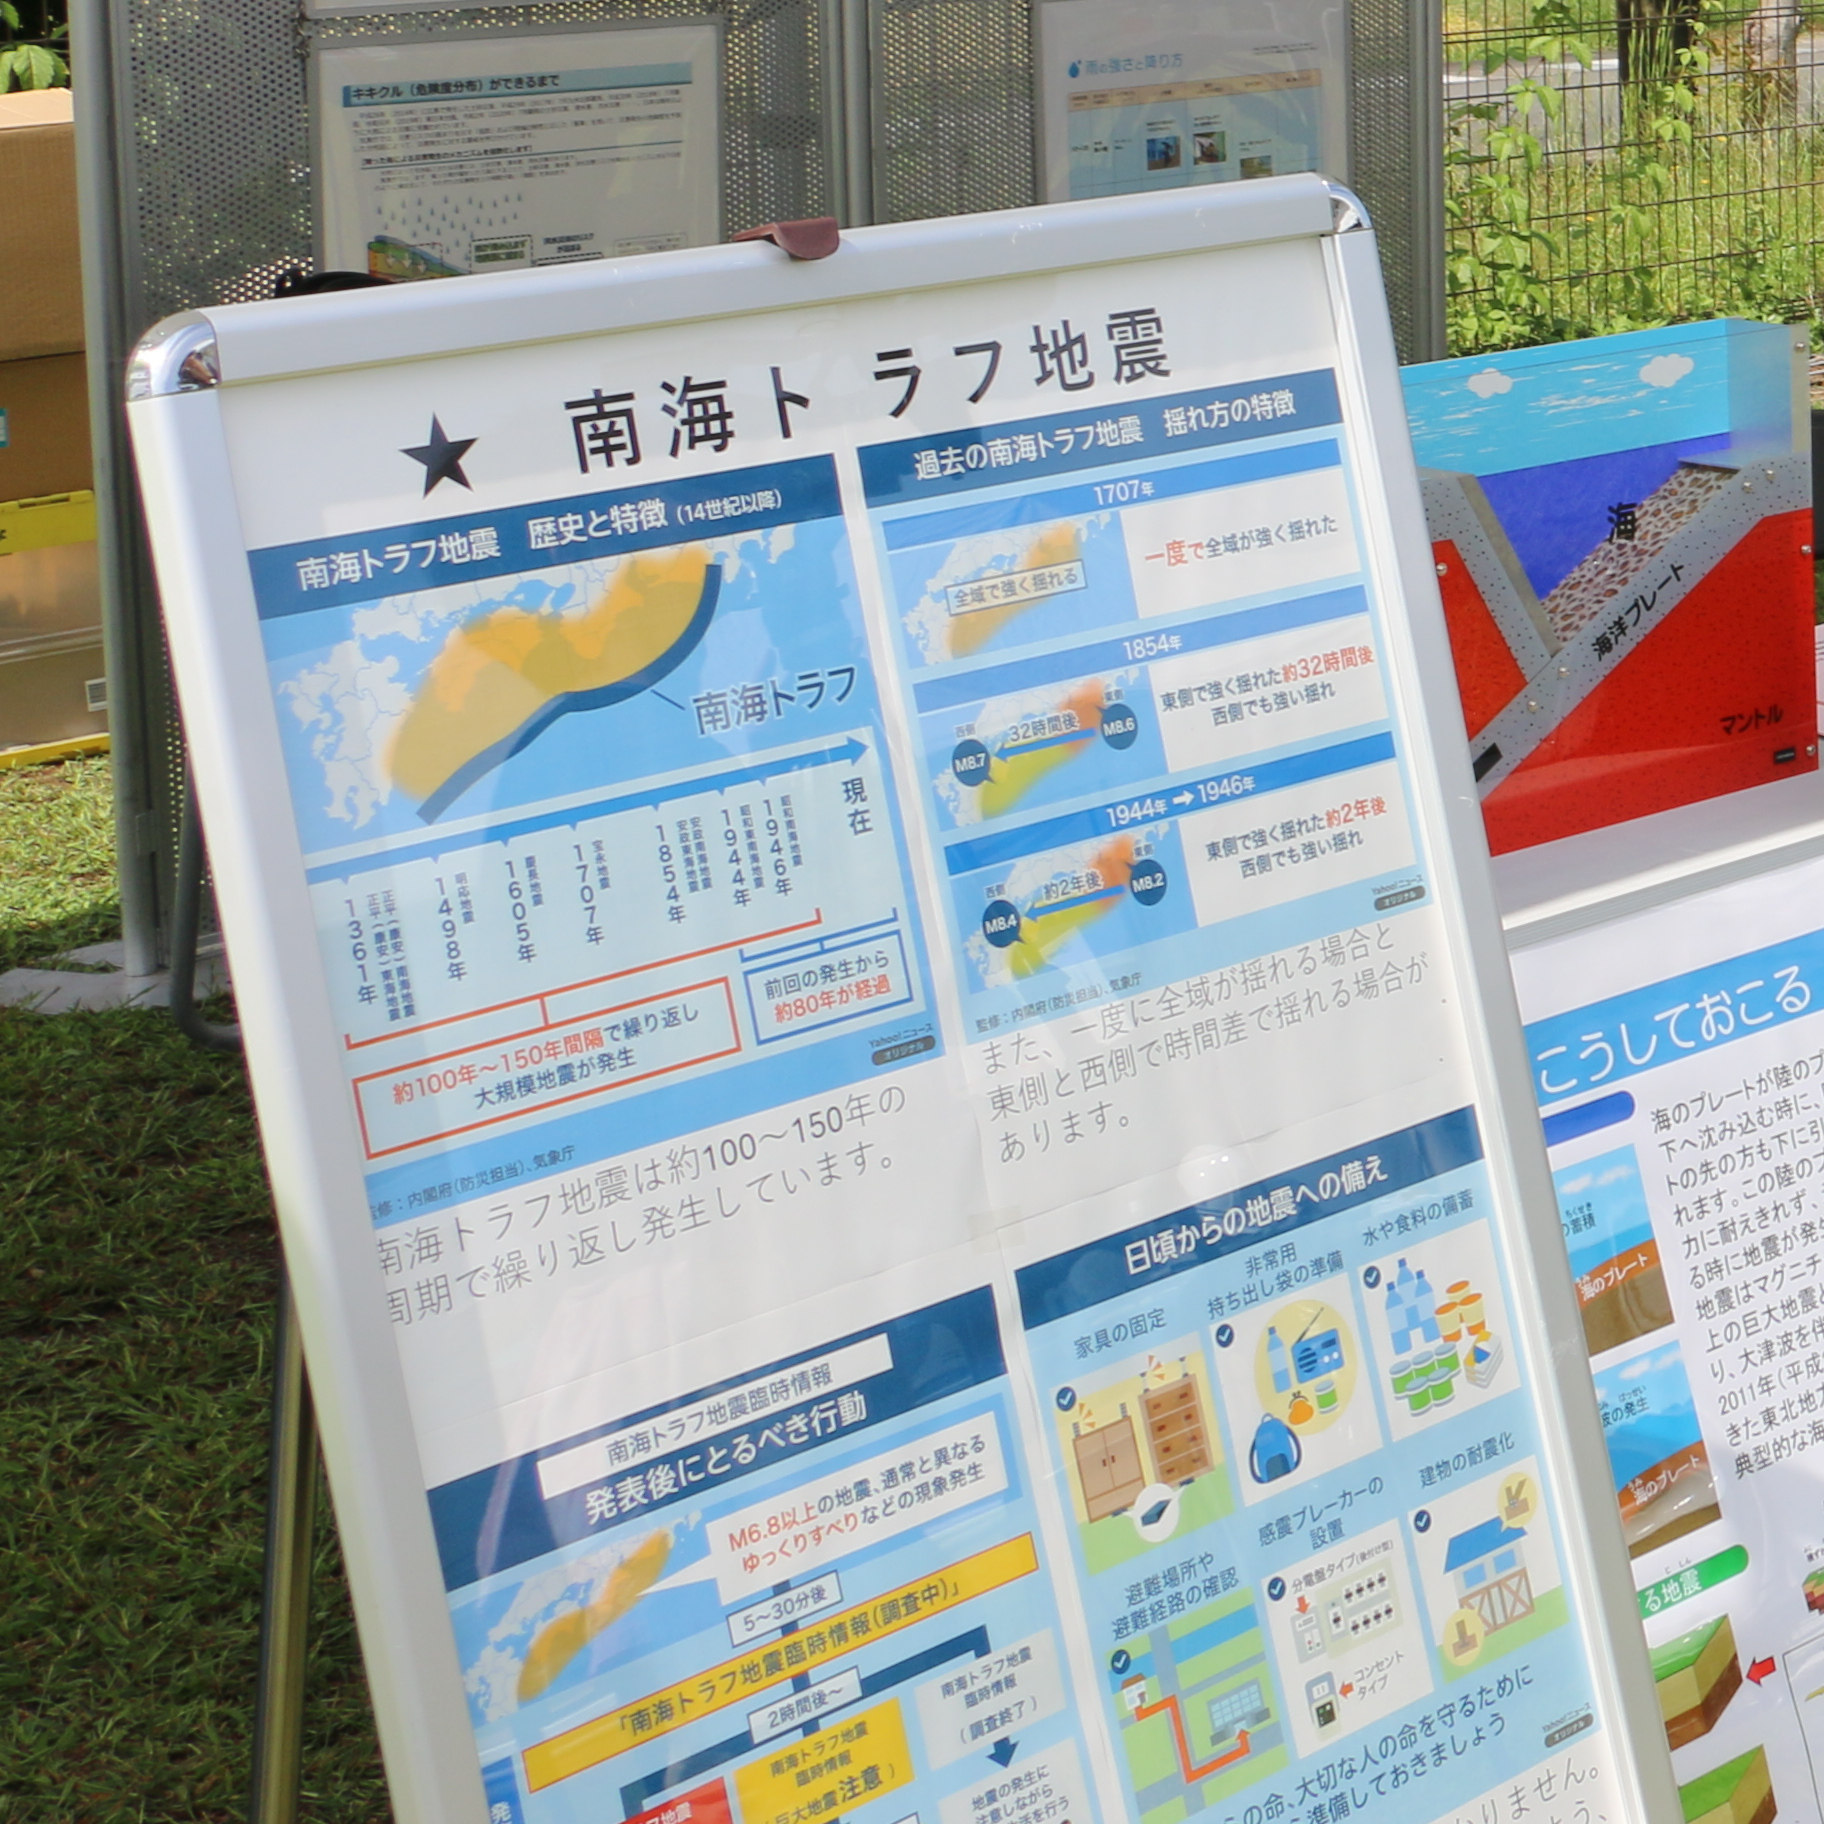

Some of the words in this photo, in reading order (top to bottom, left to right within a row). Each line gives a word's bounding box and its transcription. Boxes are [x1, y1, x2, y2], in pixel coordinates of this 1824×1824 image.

[563, 307, 1172, 475] 南海トラフ地震
[913, 415, 1145, 481] 過去の南海トラフ地震
[1163, 389, 1297, 437] 揺れ方の特徴
[1092, 478, 1155, 506] 1707年
[296, 526, 501, 590] 南海トラフ地震
[527, 498, 668, 550] 歴史と特徴
[1144, 514, 1338, 567] 一度で全域が強く揺れた
[1607, 501, 1637, 545] 海
[953, 567, 1079, 608] 全域で強く揺れる
[1591, 561, 1685, 661] 海洋プレート
[1123, 634, 1183, 660] 1854年
[690, 665, 858, 735] 南海トラフ
[1104, 688, 1126, 704] 東側
[1160, 646, 1376, 712] 東側で強く揺れた約32時間後
[1211, 681, 1336, 728] 西側でも強い揺れ
[1007, 711, 1081, 742] 32時間後
[1102, 716, 1136, 737] M8.6
[1720, 704, 1783, 735] マントル
[953, 753, 988, 774] M8.7
[841, 775, 874, 836] 現在
[1106, 798, 1168, 827] 1944年
[1196, 774, 1257, 803] 1946年
[676, 819, 701, 893] 安政東海地震
[689, 816, 713, 890] 安政南海地震
[722, 808, 751, 907] 1944年
[739, 804, 764, 889] 昭和東南海地震
[763, 799, 792, 897] 1946年
[780, 795, 803, 867] 昭和南海地震
[1205, 796, 1388, 863] 東側で強く揺れた約2年後
[1239, 829, 1364, 879] 西側でも強い揺れ
[525, 855, 544, 907] 慶長地震
[592, 839, 612, 890] 宝永地震
[655, 825, 687, 924] 1854年
[1043, 870, 1105, 901] 約2年後
[1131, 871, 1166, 892] M8.2
[454, 872, 475, 924] 明応地震
[504, 860, 537, 963] 1605年
[573, 844, 605, 945] 1707年
[435, 878, 468, 981] 1498年
[984, 913, 1019, 934] M8.4
[345, 899, 379, 1005] 1361年
[763, 950, 891, 1000] 前回の発生から
[774, 974, 892, 1024] 約80年が経過
[980, 920, 1396, 1076] また、一度に全域が揺れる場合と
[392, 1001, 700, 1105] 約100年～150年間隔で繰り返し
[988, 951, 1430, 1124] 東側と西側で時間差で揺れる場合が
[1536, 964, 1812, 1096] こうしておこる
[475, 1047, 637, 1110] 大規模地震が発生
[1000, 1098, 1130, 1165] あります。
[388, 1139, 895, 1326] 周期で繰り返し発生しています。
[1124, 1154, 1390, 1276] 日頃からの地震への備え
[1362, 1188, 1476, 1248] 水や食料の備蓄
[1206, 1250, 1345, 1320] 持ち出し袋の準備
[1244, 1243, 1298, 1278] 非常用
[1580, 1251, 1650, 1303] 海のプレート
[1073, 1308, 1168, 1362] 家具の固定
[606, 1362, 833, 1466] 南海トラフ地震臨時情報
[585, 1390, 868, 1526] 発表後にとるべき行動
[1419, 1433, 1516, 1488] 建物の耐震化
[1632, 1453, 1700, 1507] 海のプレート
[728, 1433, 987, 1551] M6.8以上の地震、通常と異なる
[741, 1461, 987, 1573] ゆっくりすべりなどの現象発生
[1257, 1477, 1386, 1548] 感震ブレーカーの
[1310, 1518, 1346, 1549] 設置
[1111, 1562, 1240, 1642] 避難経路の確認
[1124, 1550, 1216, 1606] 避難場所や
[1637, 1568, 1703, 1615] る地震
[743, 1584, 827, 1634] 5～30分後
[941, 1646, 1033, 1699] 南海トラフ地震
[965, 1674, 1018, 1710] 臨時情報
[1352, 1650, 1406, 1685] コンセント
[1357, 1674, 1390, 1700] タイプ
[766, 1685, 844, 1729] 2時間後～
[770, 1720, 870, 1779] 南海トラフ地震
[794, 1748, 853, 1787] 臨時情報
[1222, 1663, 1534, 1824] の命、大切な人の命を守るために
[972, 1763, 1050, 1813] 地震の発生に
[975, 1783, 1055, 1824] 注意しながら
